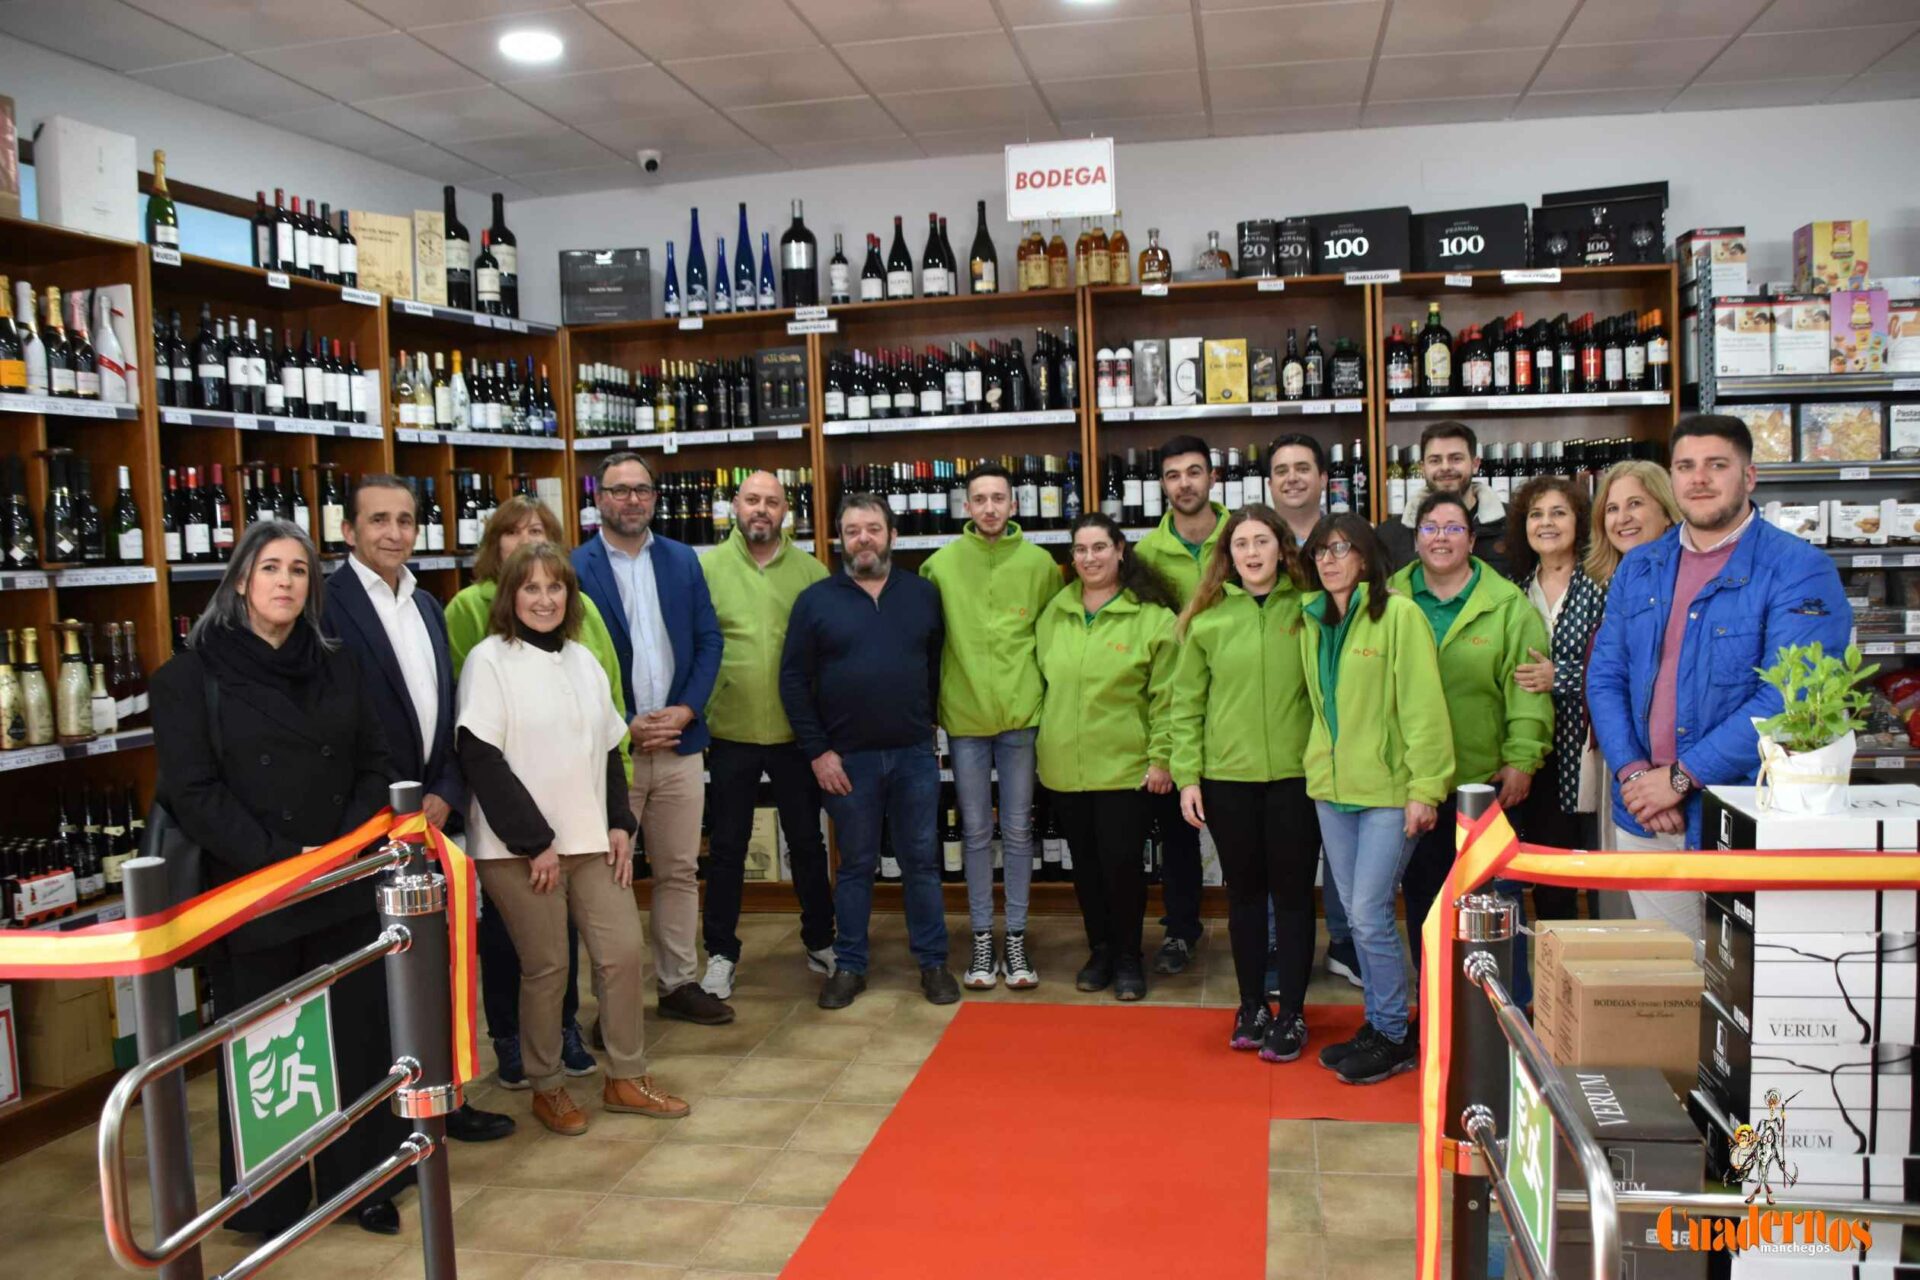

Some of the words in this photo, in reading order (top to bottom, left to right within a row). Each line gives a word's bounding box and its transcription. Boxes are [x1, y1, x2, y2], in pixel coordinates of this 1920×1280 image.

[1015, 165, 1107, 190] BODEGA
[1242, 243, 1267, 259] 20
[1278, 243, 1303, 258] 20
[1323, 236, 1369, 260] 100
[1438, 234, 1486, 258] 100
[1586, 240, 1610, 253] 100
[1593, 999, 1637, 1008] BODEGAS
[1768, 1022, 1837, 1038] VERUM
[1576, 1073, 1630, 1127] VERUM
